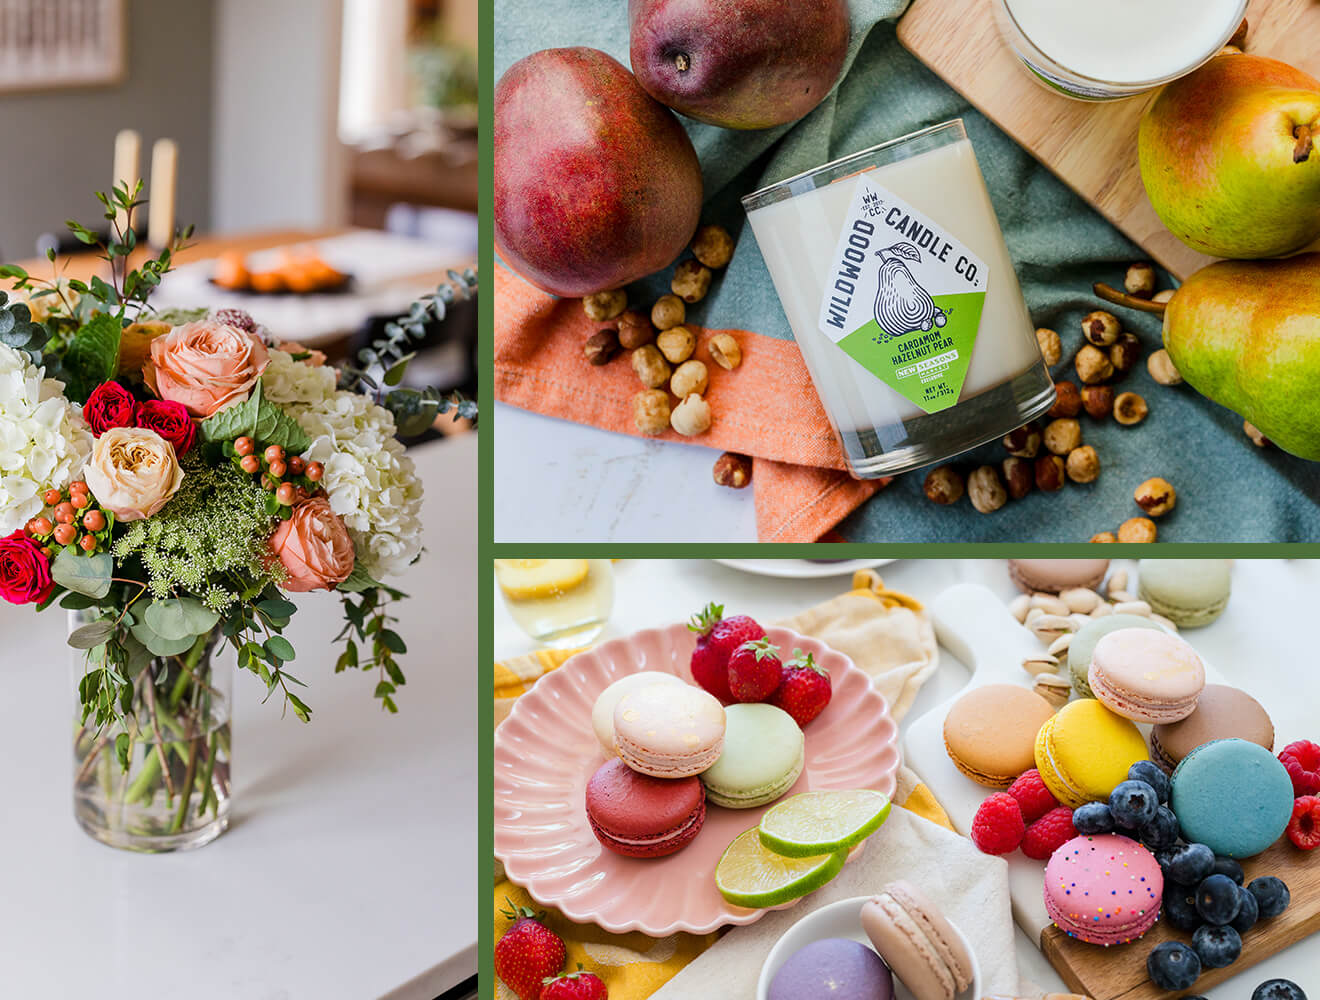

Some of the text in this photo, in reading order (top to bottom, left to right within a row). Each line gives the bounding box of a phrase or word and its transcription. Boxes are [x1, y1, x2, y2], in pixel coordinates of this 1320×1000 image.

[884, 207, 953, 263] CANDLE
[826, 219, 876, 330] WILDWOOD
[891, 336, 954, 366] HAZELNUT PEAR
[897, 330, 942, 353] CARDAMOM
